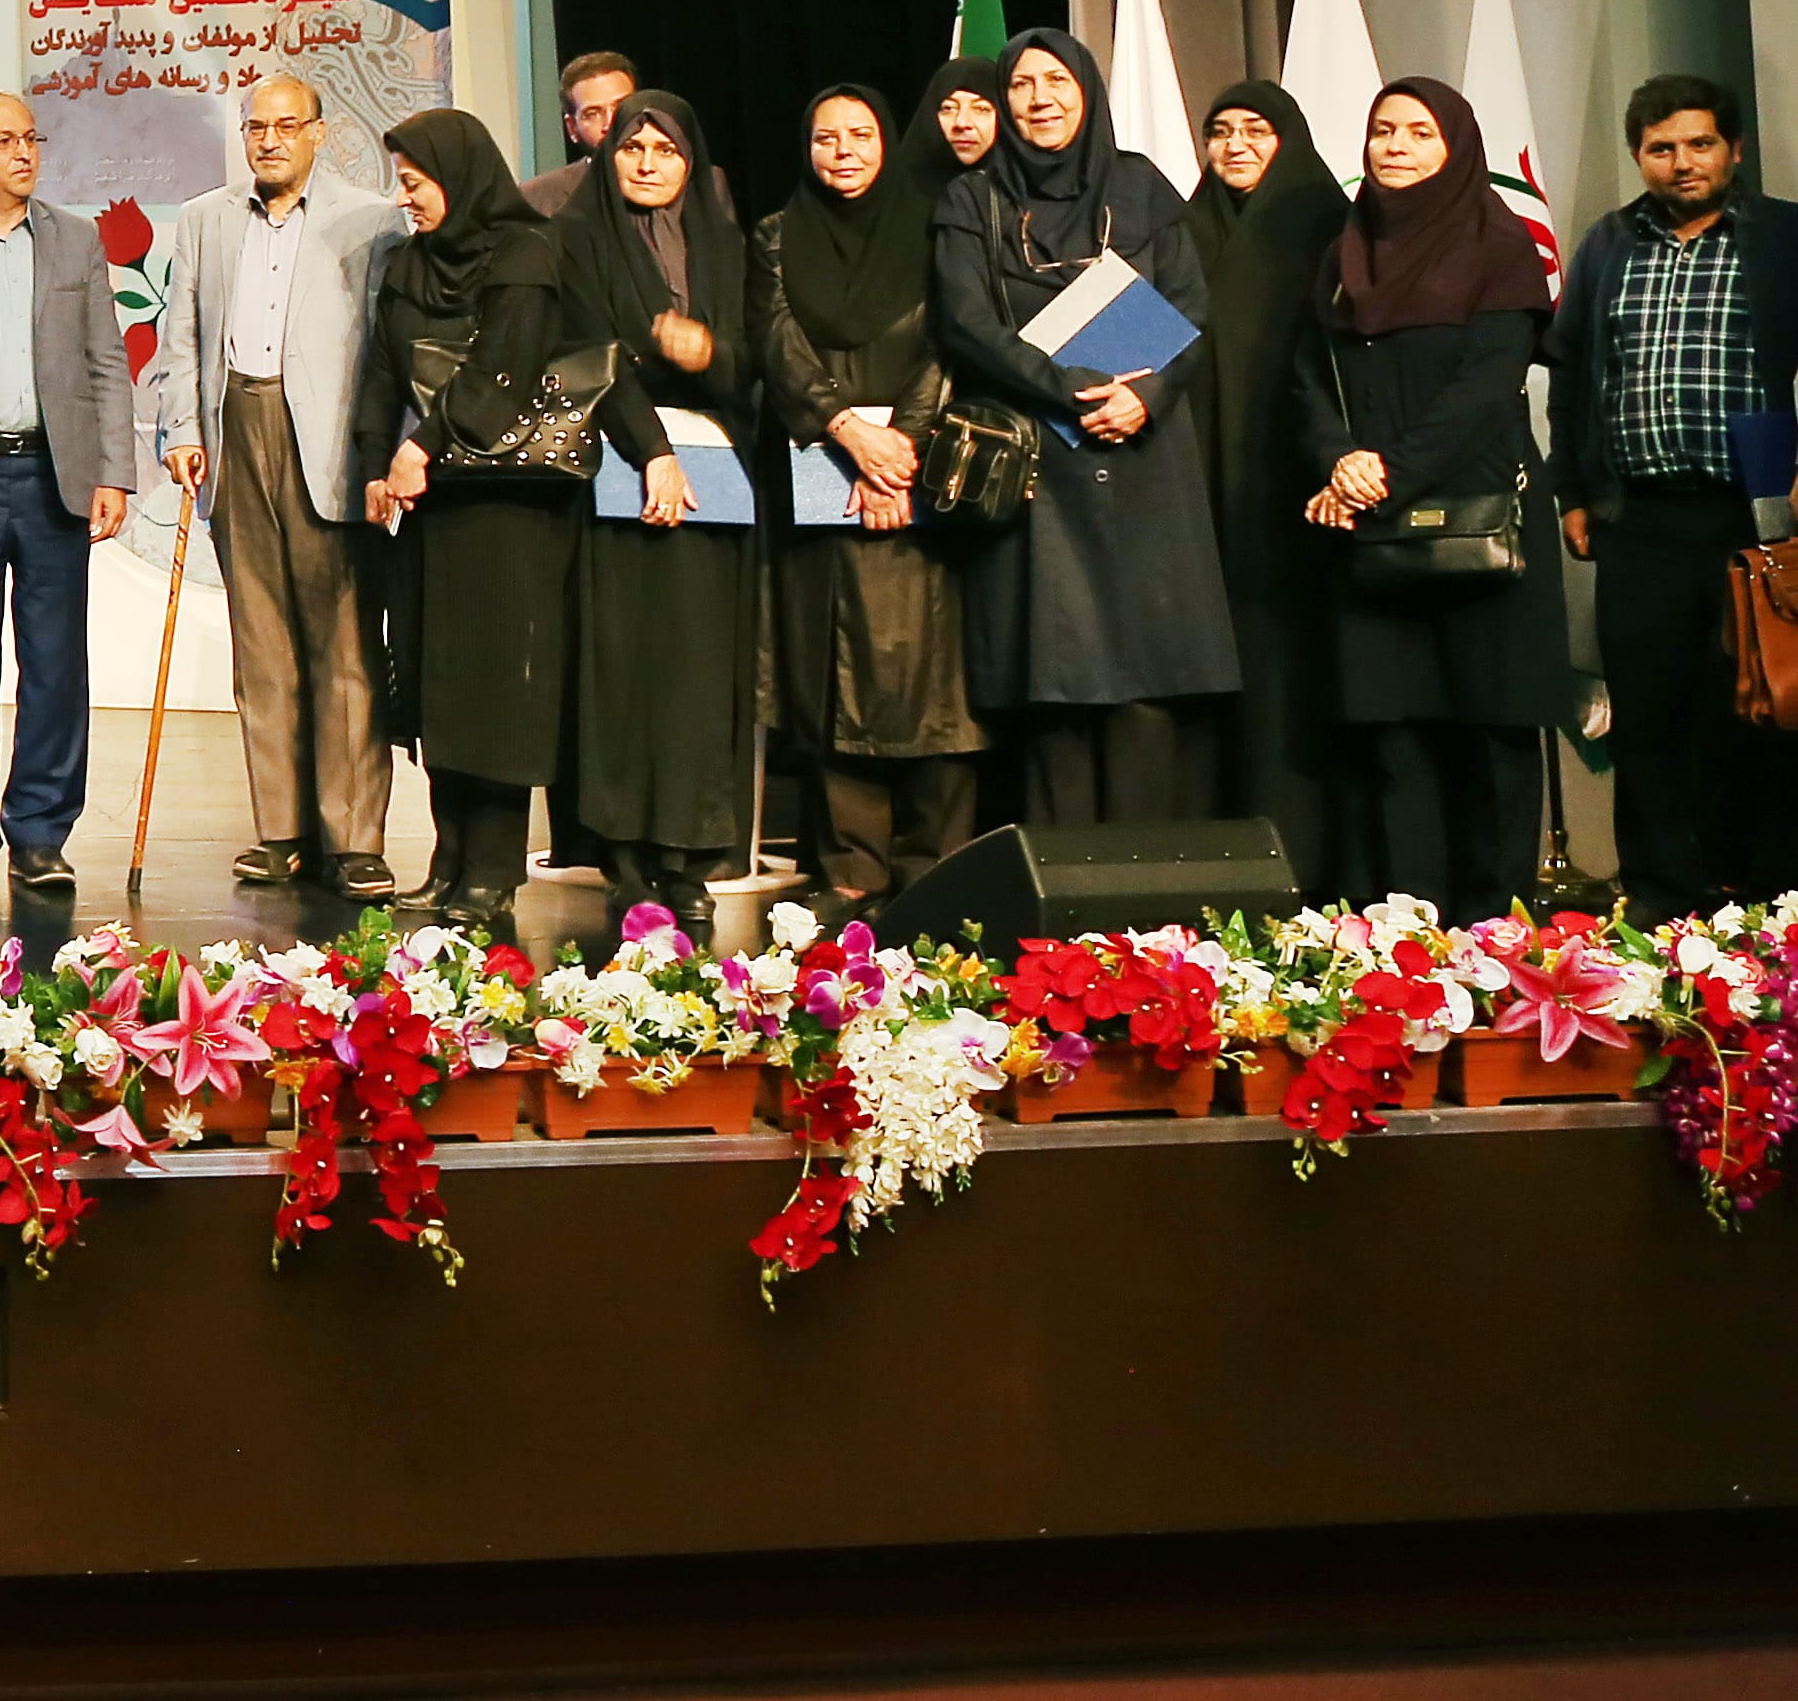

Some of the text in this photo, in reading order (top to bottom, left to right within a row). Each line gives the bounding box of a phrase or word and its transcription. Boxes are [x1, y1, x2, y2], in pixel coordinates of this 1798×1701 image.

[30, 20, 362, 58] تجلیل از مولفان و پدید آورندگان
[30, 62, 263, 101] اد و رسانه های آموزشی
